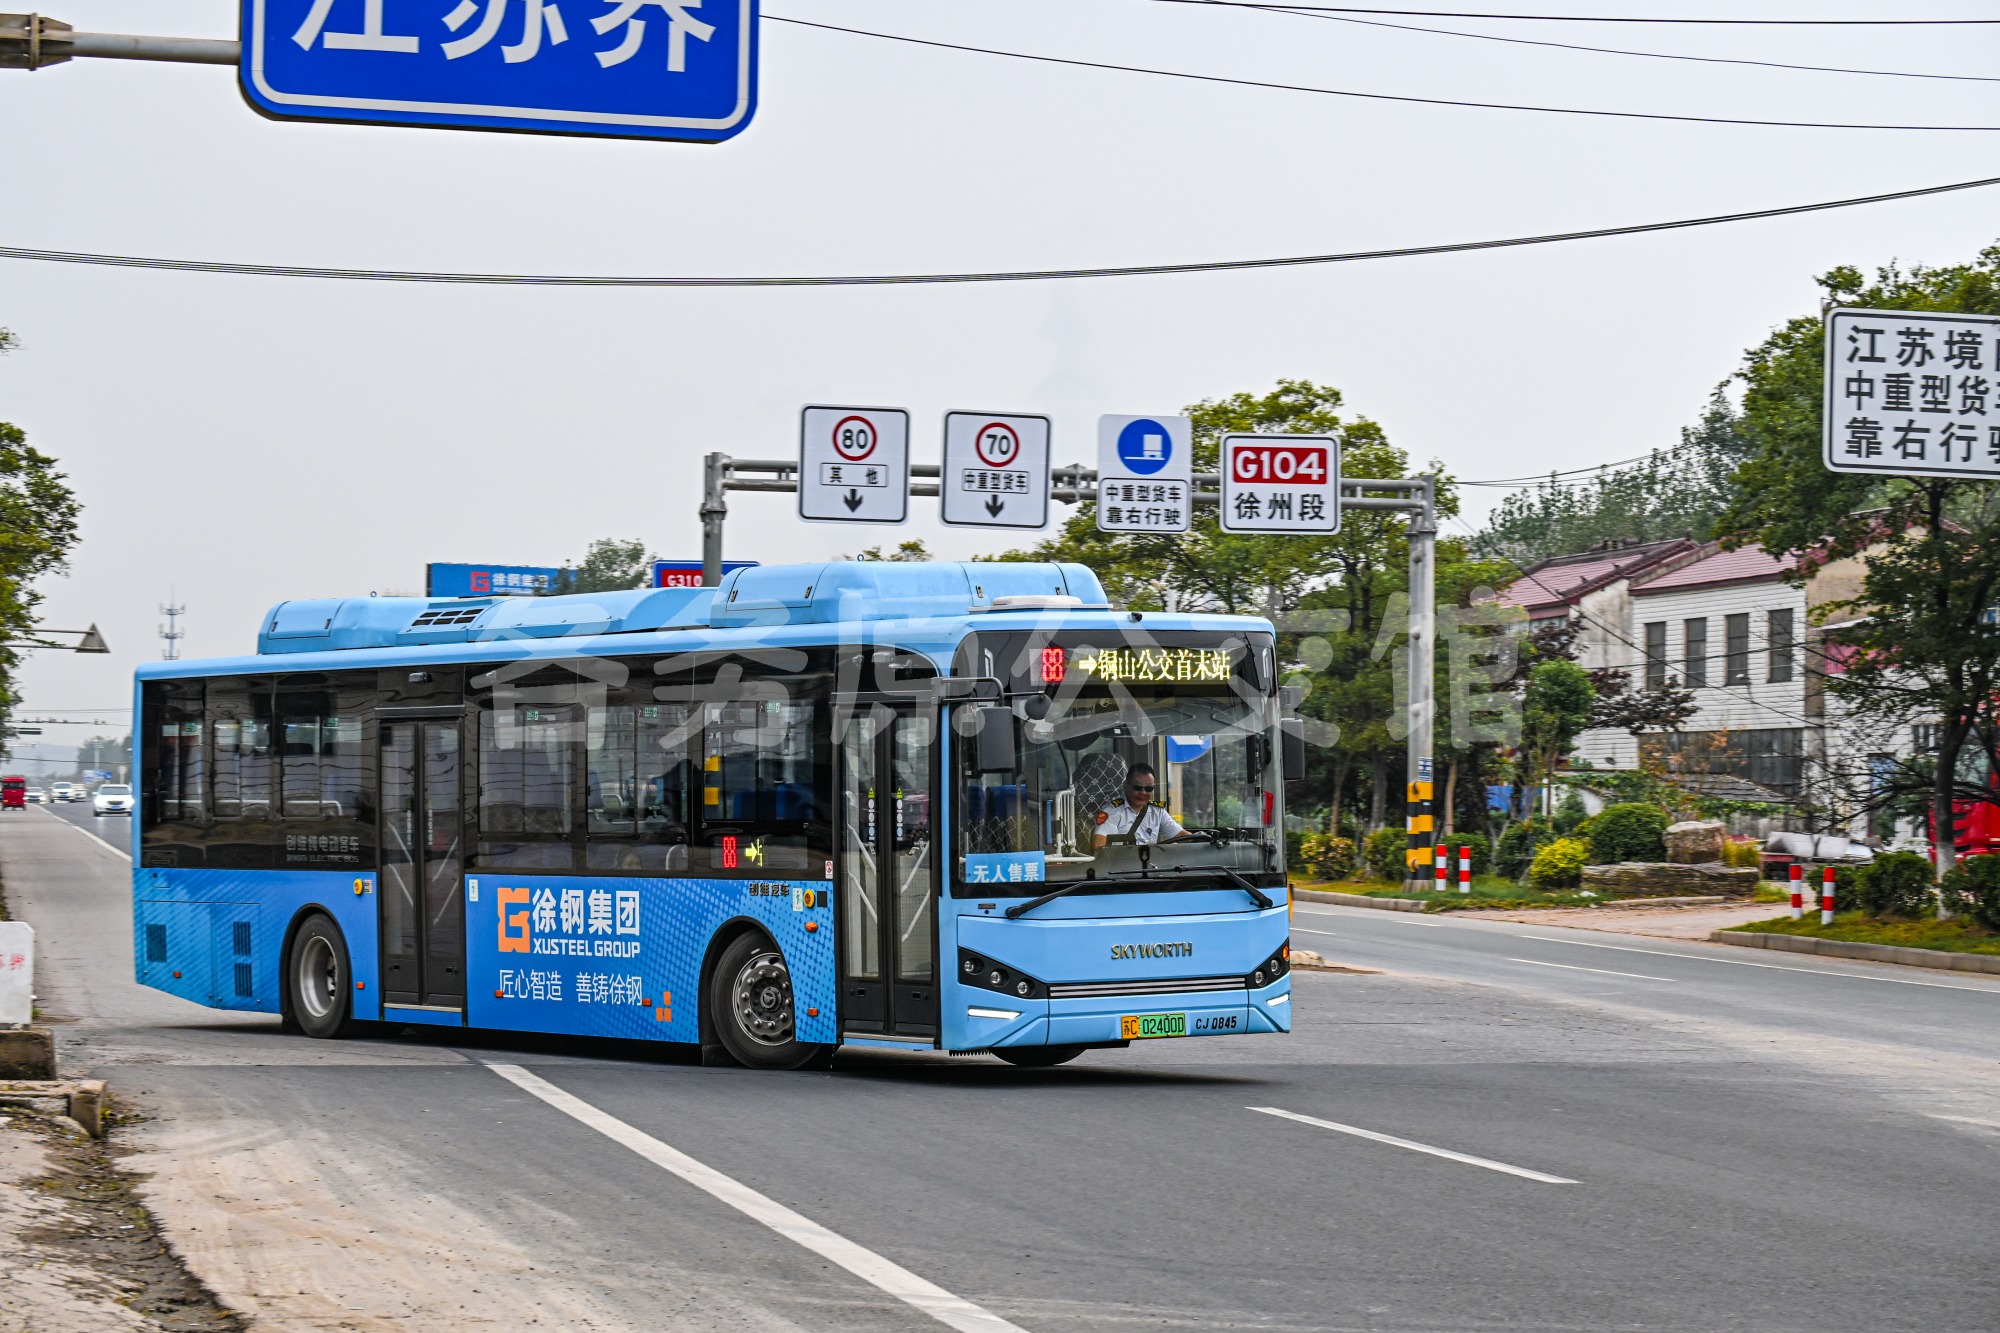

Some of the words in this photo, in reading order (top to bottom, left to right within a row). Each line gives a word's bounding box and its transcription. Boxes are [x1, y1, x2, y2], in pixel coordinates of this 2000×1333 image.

[1847, 324, 2000, 373] 江苏境
[1845, 369, 2000, 416] 中重型货
[841, 428, 869, 451] 80
[985, 433, 1011, 456] 70
[829, 465, 879, 486] 其他
[1235, 450, 1325, 481] G104
[963, 471, 1029, 491] 中重型货车
[1105, 483, 1182, 504] 中重型货车
[1106, 506, 1182, 526] 靠右行驶
[1234, 491, 1326, 522] 徐州段
[667, 574, 703, 587] G310
[1097, 649, 1231, 681] 铜山公交首末站
[973, 861, 1039, 883] 无人售票
[532, 888, 640, 936] 徐钢集团
[533, 938, 593, 956] XUSTEEL
[594, 940, 641, 958] GROUP
[1111, 942, 1193, 960] SKYWORTH
[498, 968, 563, 1002] 匠心智造
[576, 971, 643, 1007] 善铸徐钢
